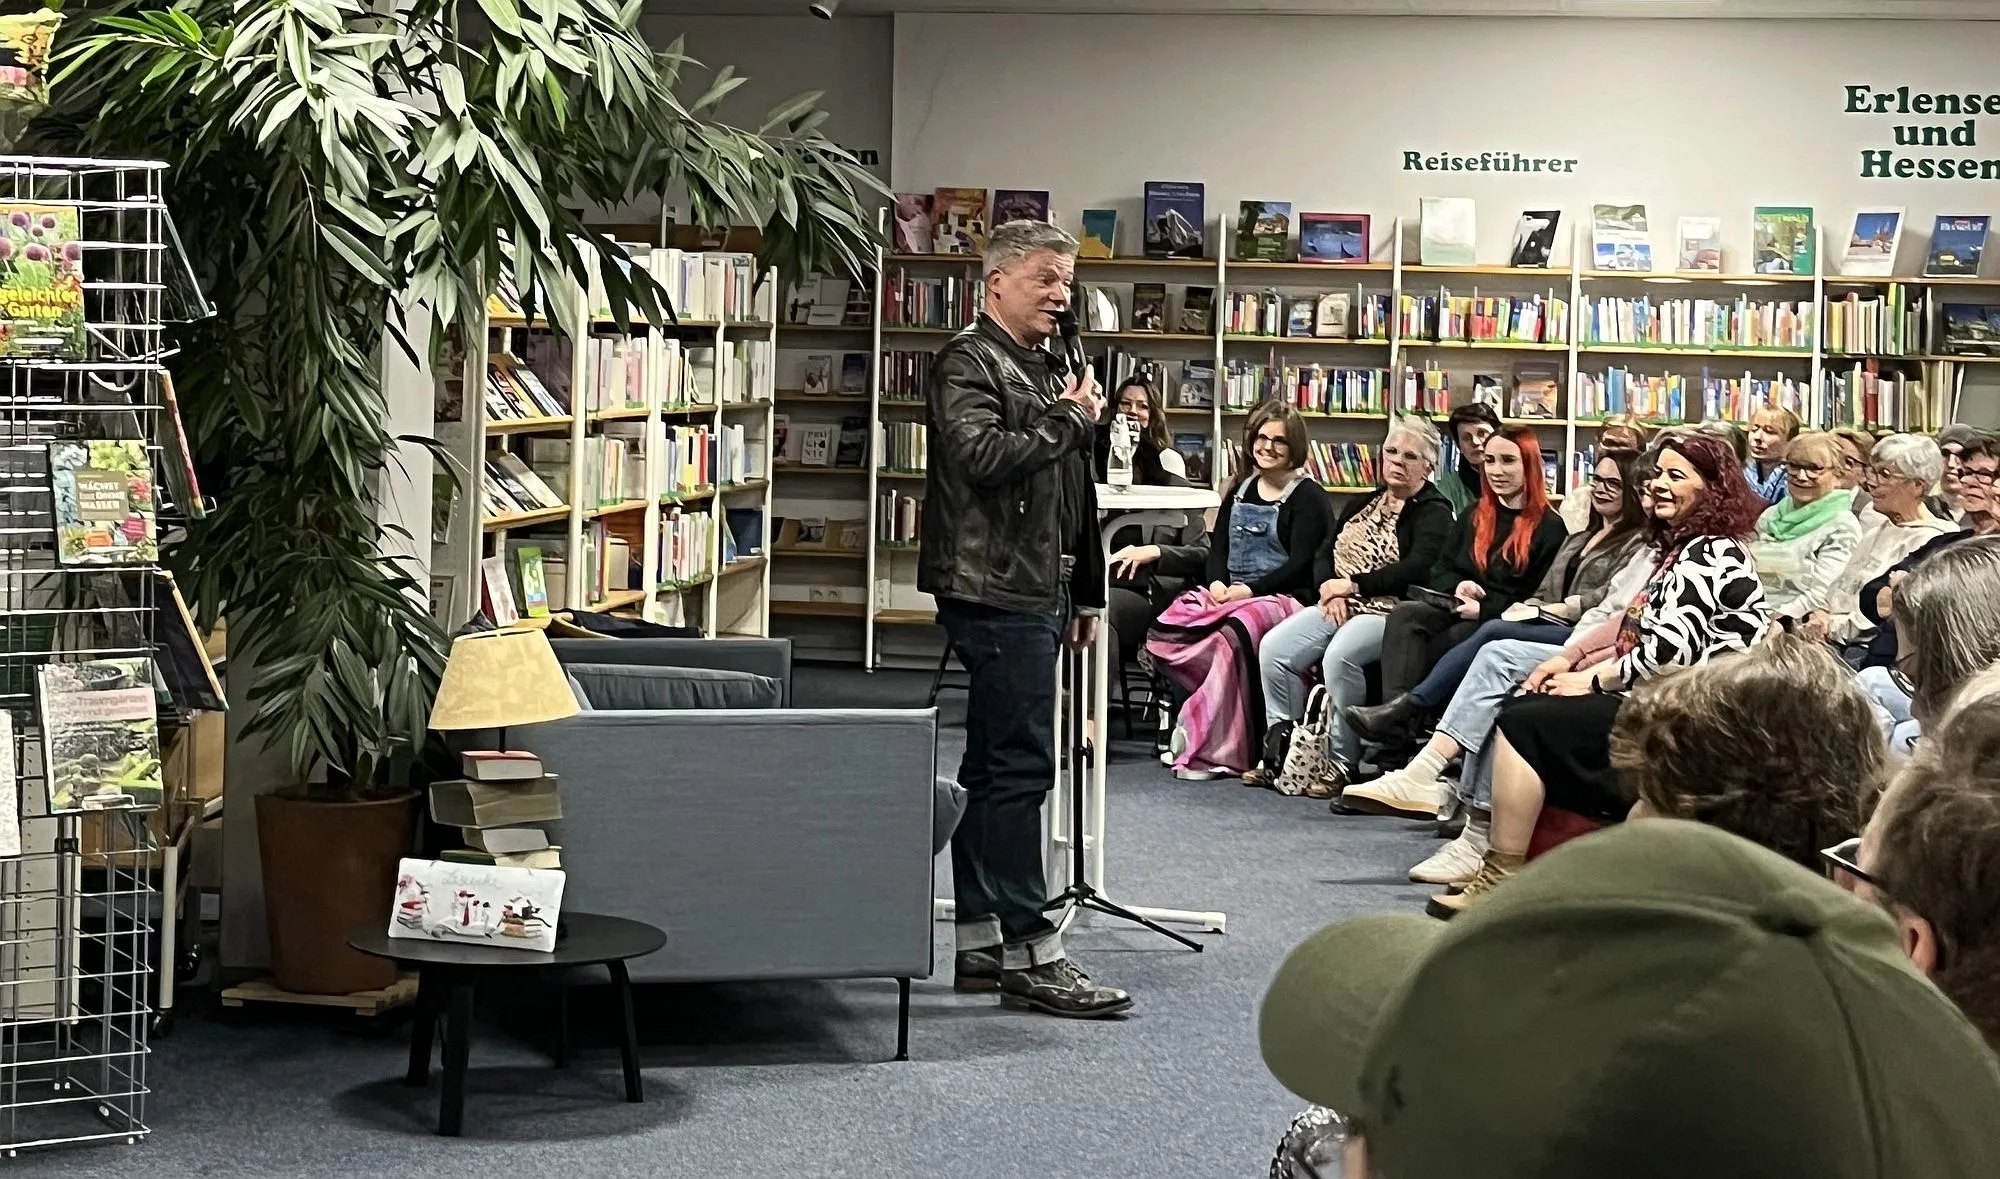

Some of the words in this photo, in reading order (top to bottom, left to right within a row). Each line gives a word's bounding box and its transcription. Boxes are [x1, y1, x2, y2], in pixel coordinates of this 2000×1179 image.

[1844, 85, 2000, 115] Erlense
[1893, 119, 1976, 147] und
[1402, 150, 1578, 173] Reiseführer
[1860, 150, 2000, 180] Hessen
[7, 302, 63, 318] Garten
